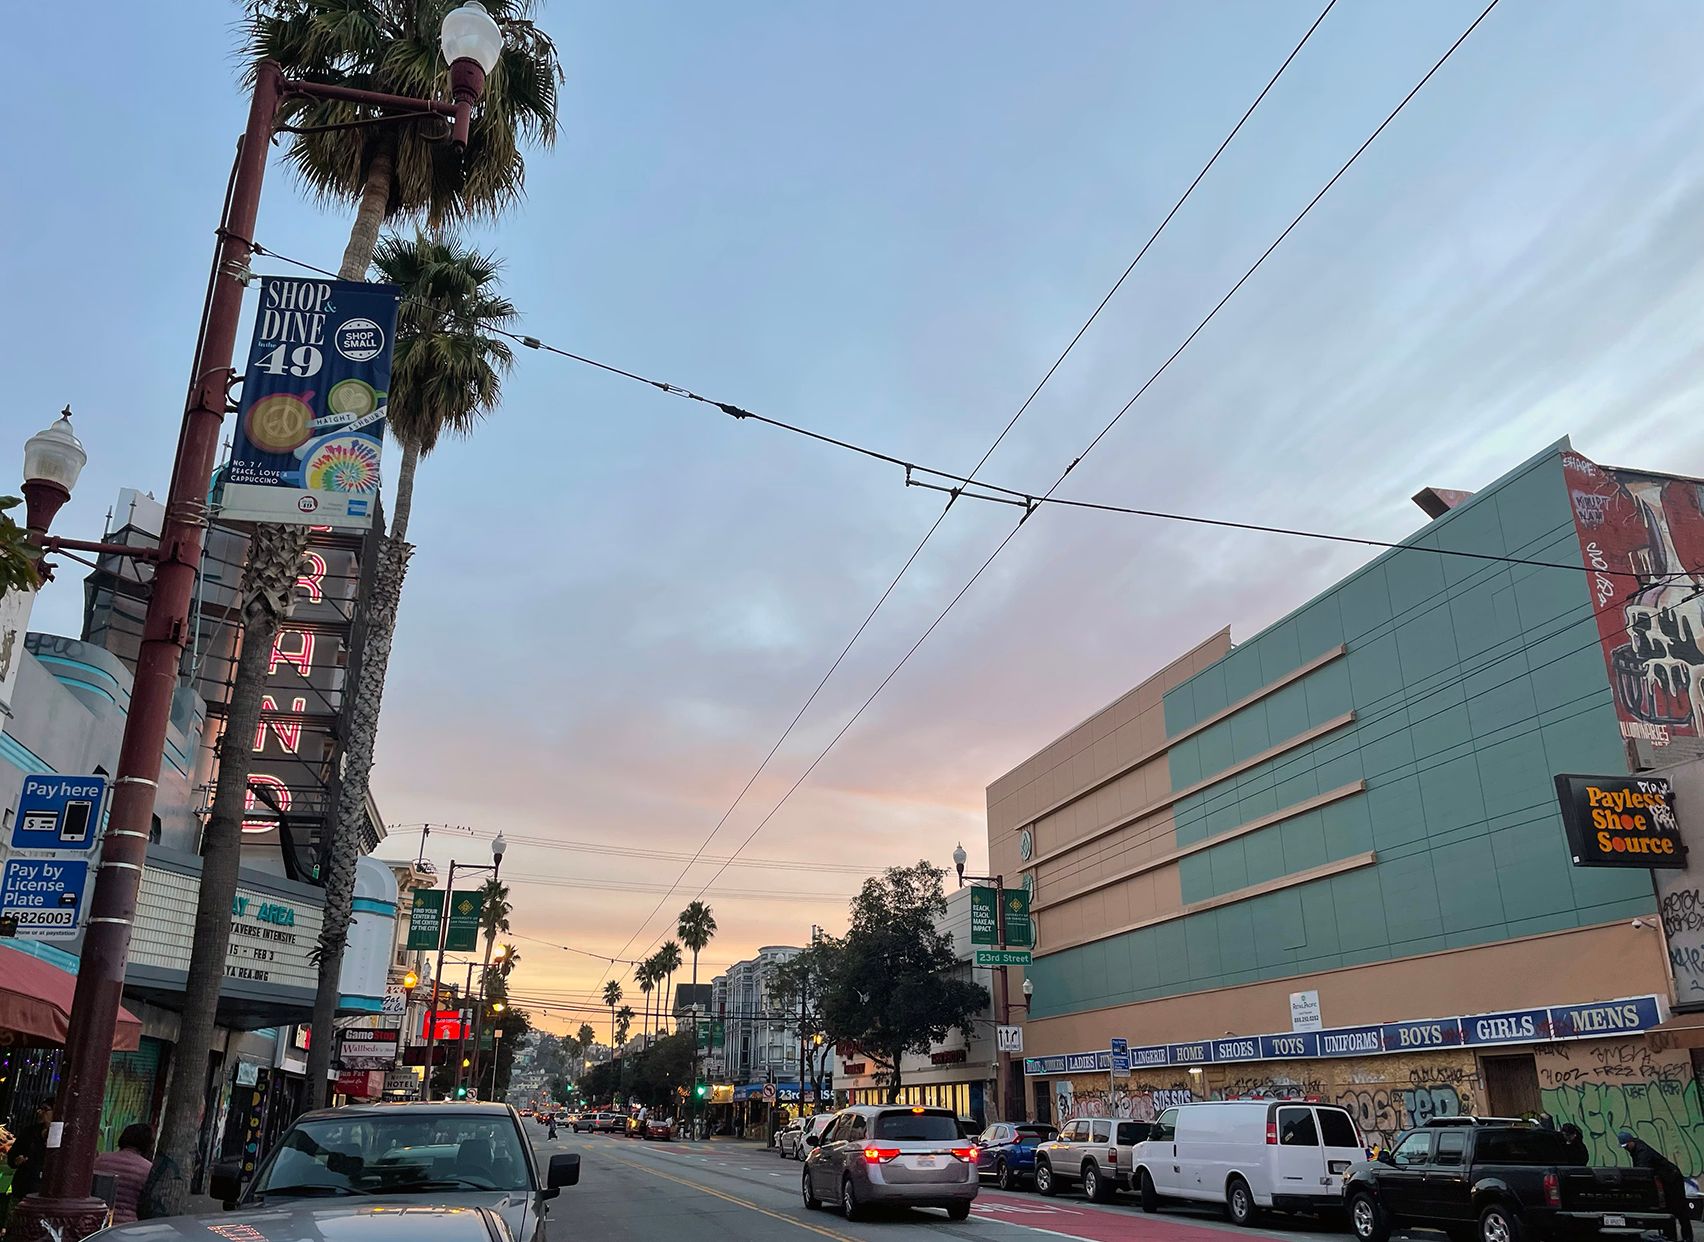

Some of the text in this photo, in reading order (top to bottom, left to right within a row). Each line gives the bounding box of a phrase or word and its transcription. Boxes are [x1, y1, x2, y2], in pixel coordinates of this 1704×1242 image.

[266, 280, 337, 313] SHOP &
[259, 309, 326, 345] DINE
[343, 339, 377, 348] SMALL
[345, 332, 374, 341] SHOP
[254, 343, 323, 378] 49
[316, 414, 351, 425] HAIGHT
[348, 410, 385, 431] ASHBURY
[233, 460, 246, 468] NO.
[230, 475, 278, 485] CAPPUCCINO
[232, 468, 256, 477] PEACE,
[259, 469, 280, 478] LOVE
[241, 524, 332, 833] RAND
[26, 782, 99, 799] Pay here
[1586, 786, 1665, 812] Payless
[1591, 809, 1647, 831] Shoe
[1597, 832, 1675, 854] Source
[9, 863, 64, 880] Pay by
[7, 878, 64, 891] License
[3, 892, 44, 906] Plate
[257, 903, 295, 927] AREA
[230, 922, 297, 944] TAVERSE INTENSIVE
[253, 948, 267, 960] FEB
[269, 951, 274, 961] 3
[979, 953, 1029, 963] 23rd Street
[1570, 1004, 1640, 1032] MENS
[345, 1030, 396, 1040] GameStop
[1399, 1024, 1442, 1046] BOYS
[1476, 1016, 1535, 1040] GIRLS
[343, 1044, 378, 1053] Wallbeds
[1218, 1040, 1254, 1058] SHOES
[1272, 1038, 1304, 1054] TOYS
[1324, 1032, 1379, 1053] UNIFORMS
[1069, 1055, 1094, 1069] LADIES
[1134, 1048, 1166, 1066] LINGERIE
[1176, 1045, 1203, 1062] HOME
